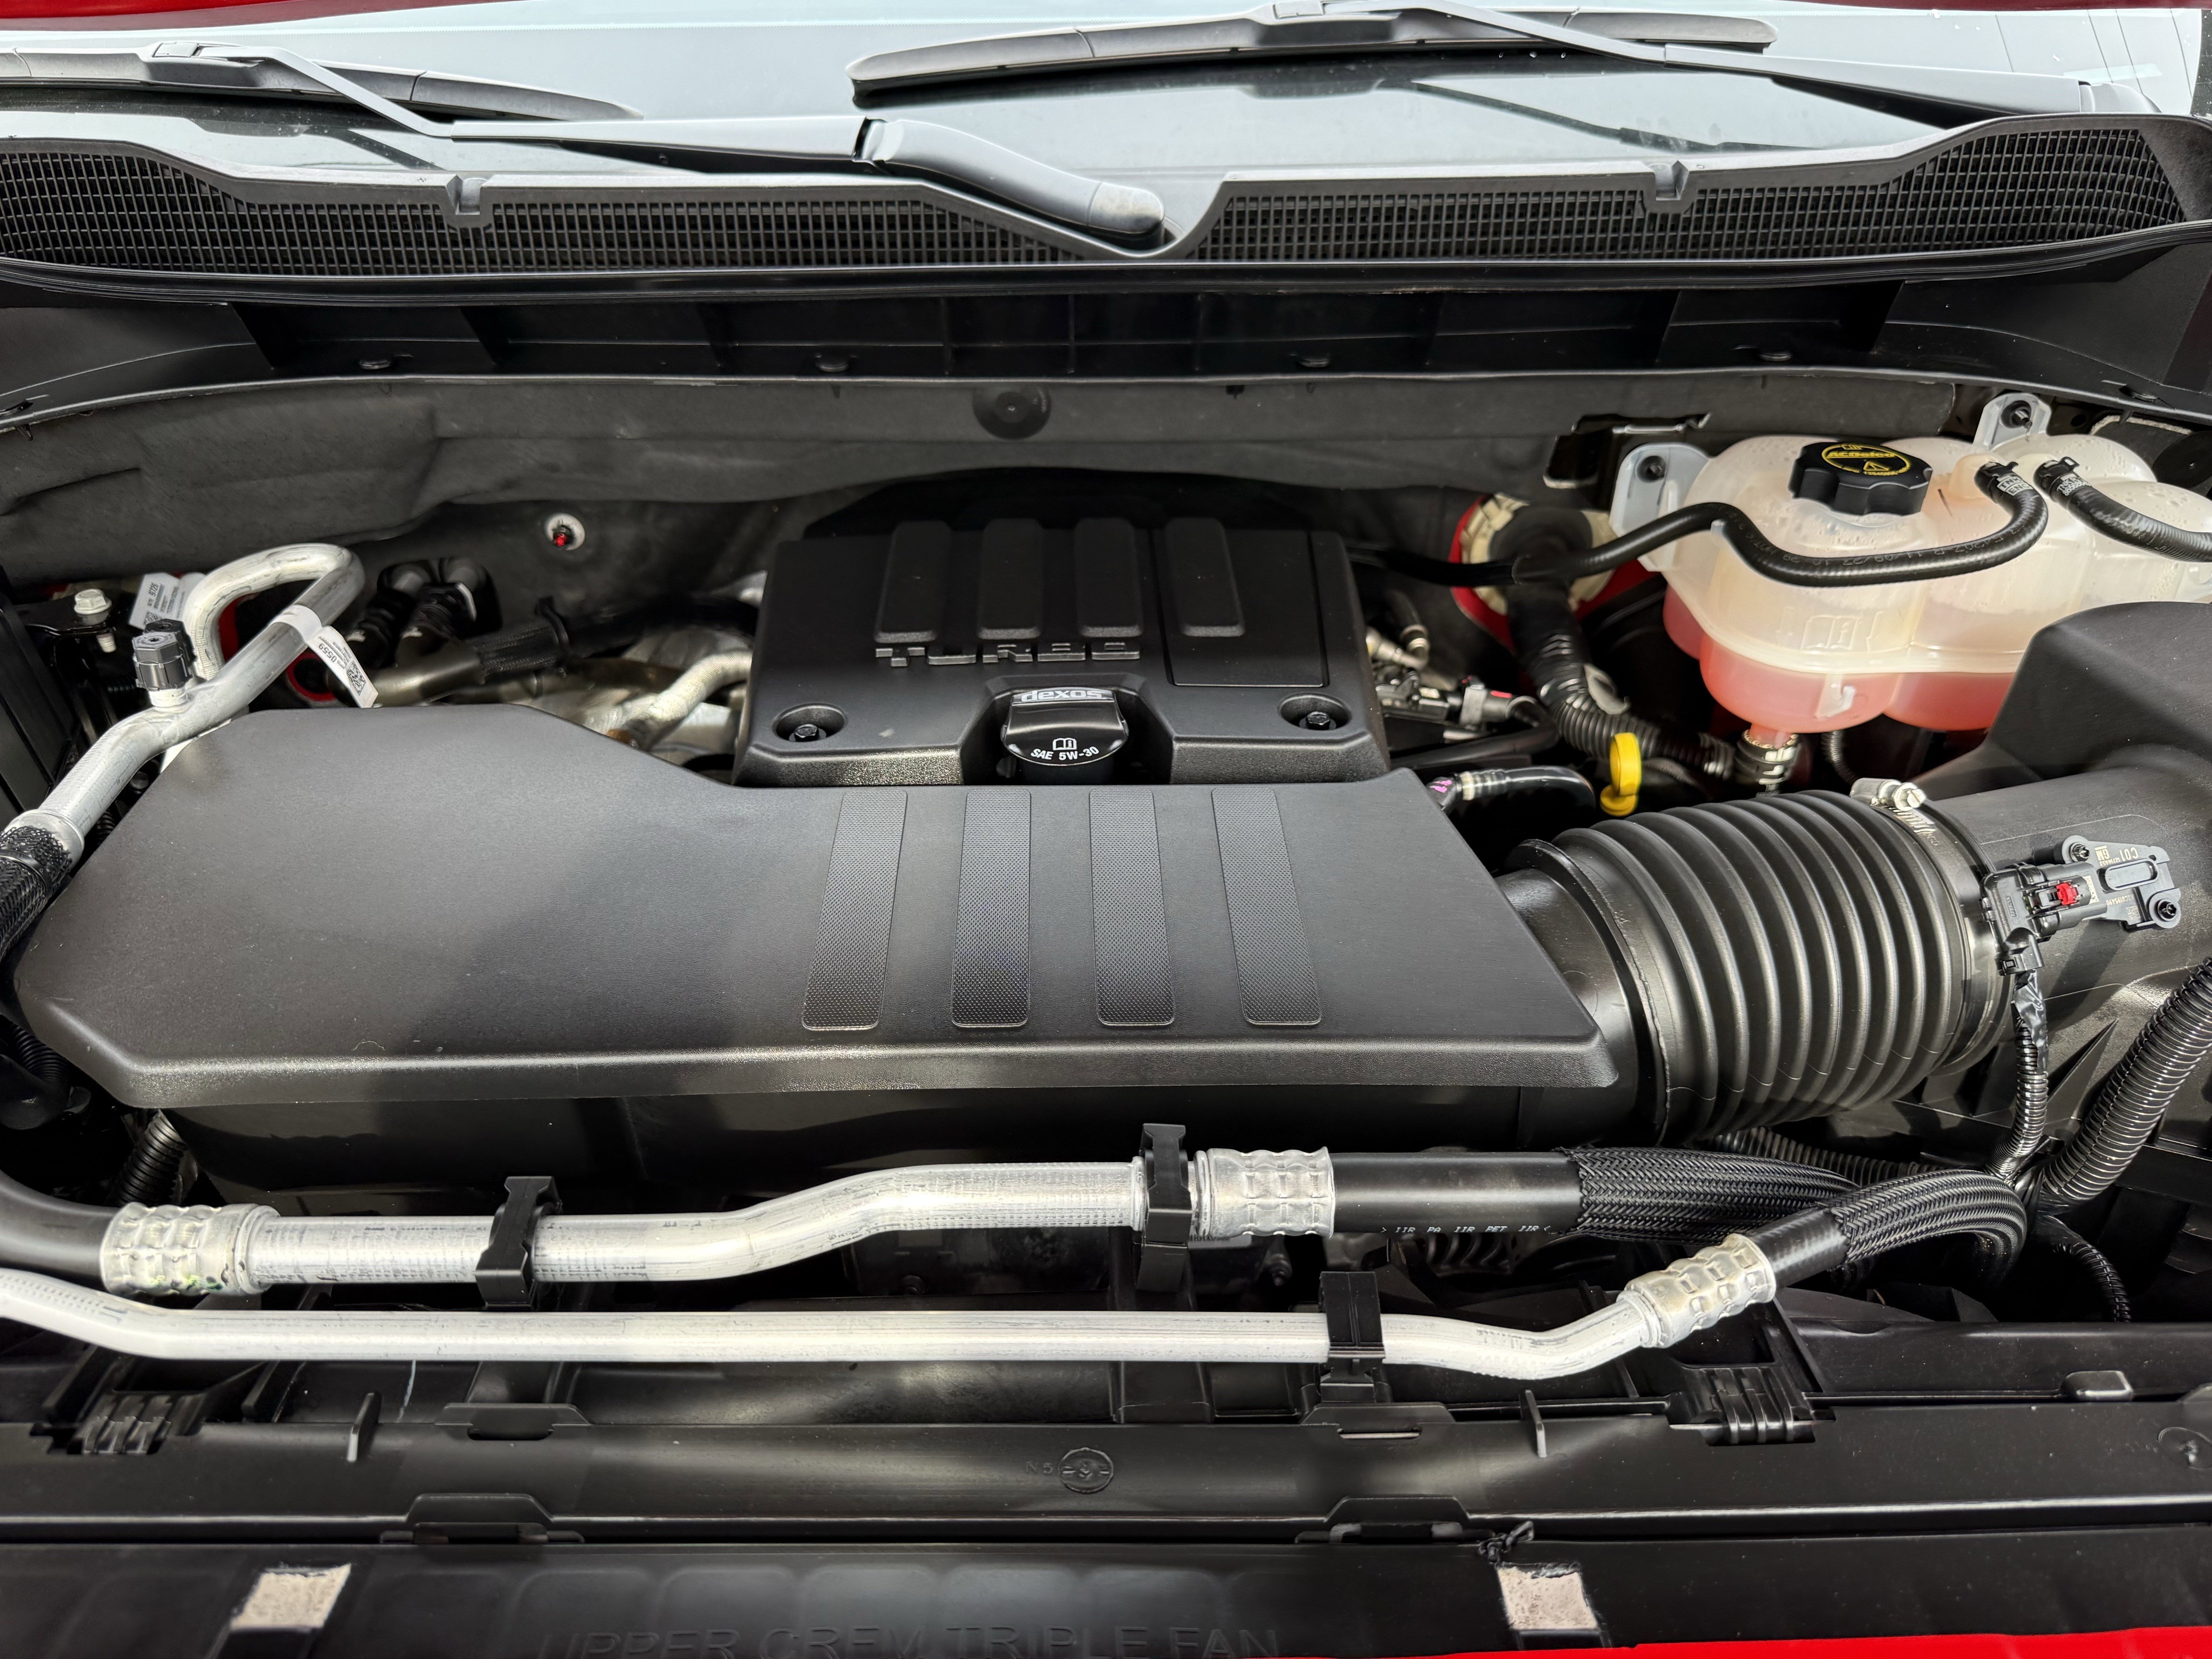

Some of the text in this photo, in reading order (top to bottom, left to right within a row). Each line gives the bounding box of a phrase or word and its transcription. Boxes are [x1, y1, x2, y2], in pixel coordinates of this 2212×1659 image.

[318, 643, 337, 663] 0559
[1021, 690, 1103, 702] dexos
[1030, 746, 1099, 761] SAE 5W-30
[2095, 848, 2110, 861] GM
[539, 1628, 740, 1659] UPPER
[946, 1626, 1149, 1659] TRIPLE
[1170, 1627, 1278, 1659] FAN
